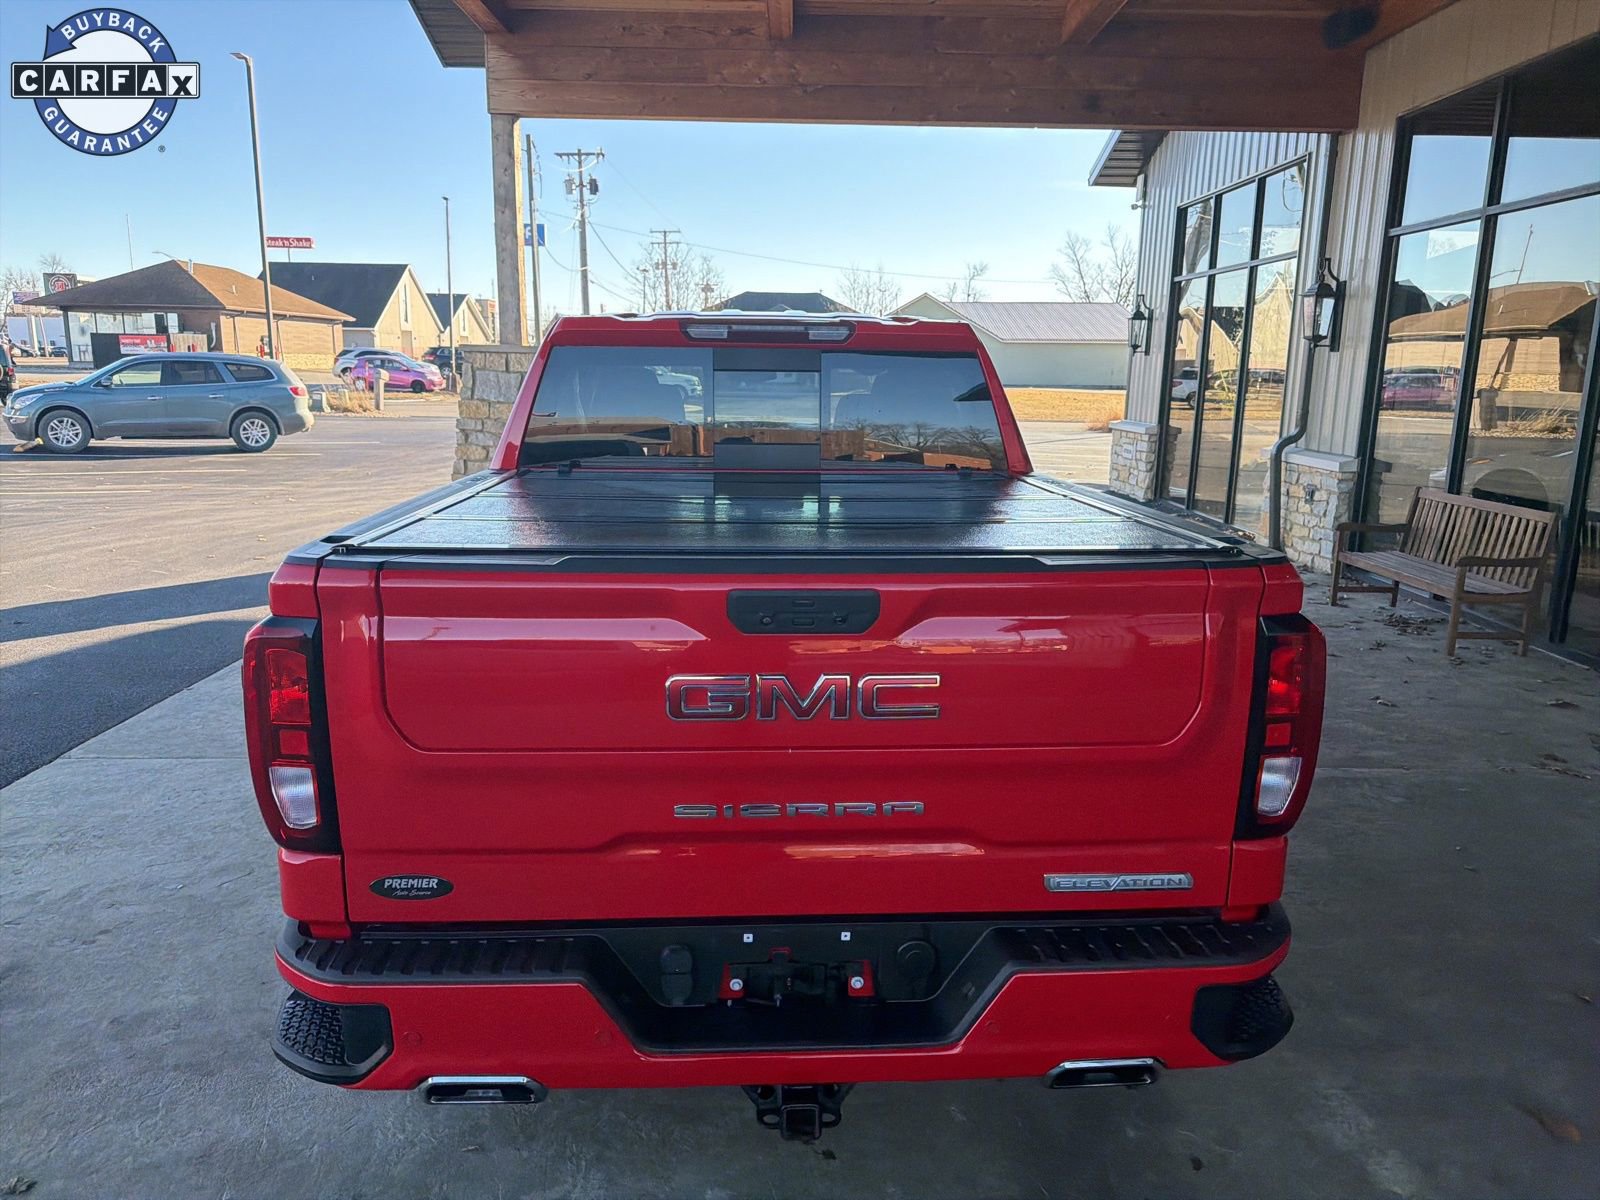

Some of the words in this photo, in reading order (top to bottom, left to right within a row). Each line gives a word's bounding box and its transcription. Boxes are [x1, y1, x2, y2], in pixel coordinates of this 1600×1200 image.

[665, 673, 940, 721] GMC
[673, 801, 925, 818] SIERRA
[384, 878, 439, 889] PREMIER
[1056, 877, 1183, 890] ELEVATION
